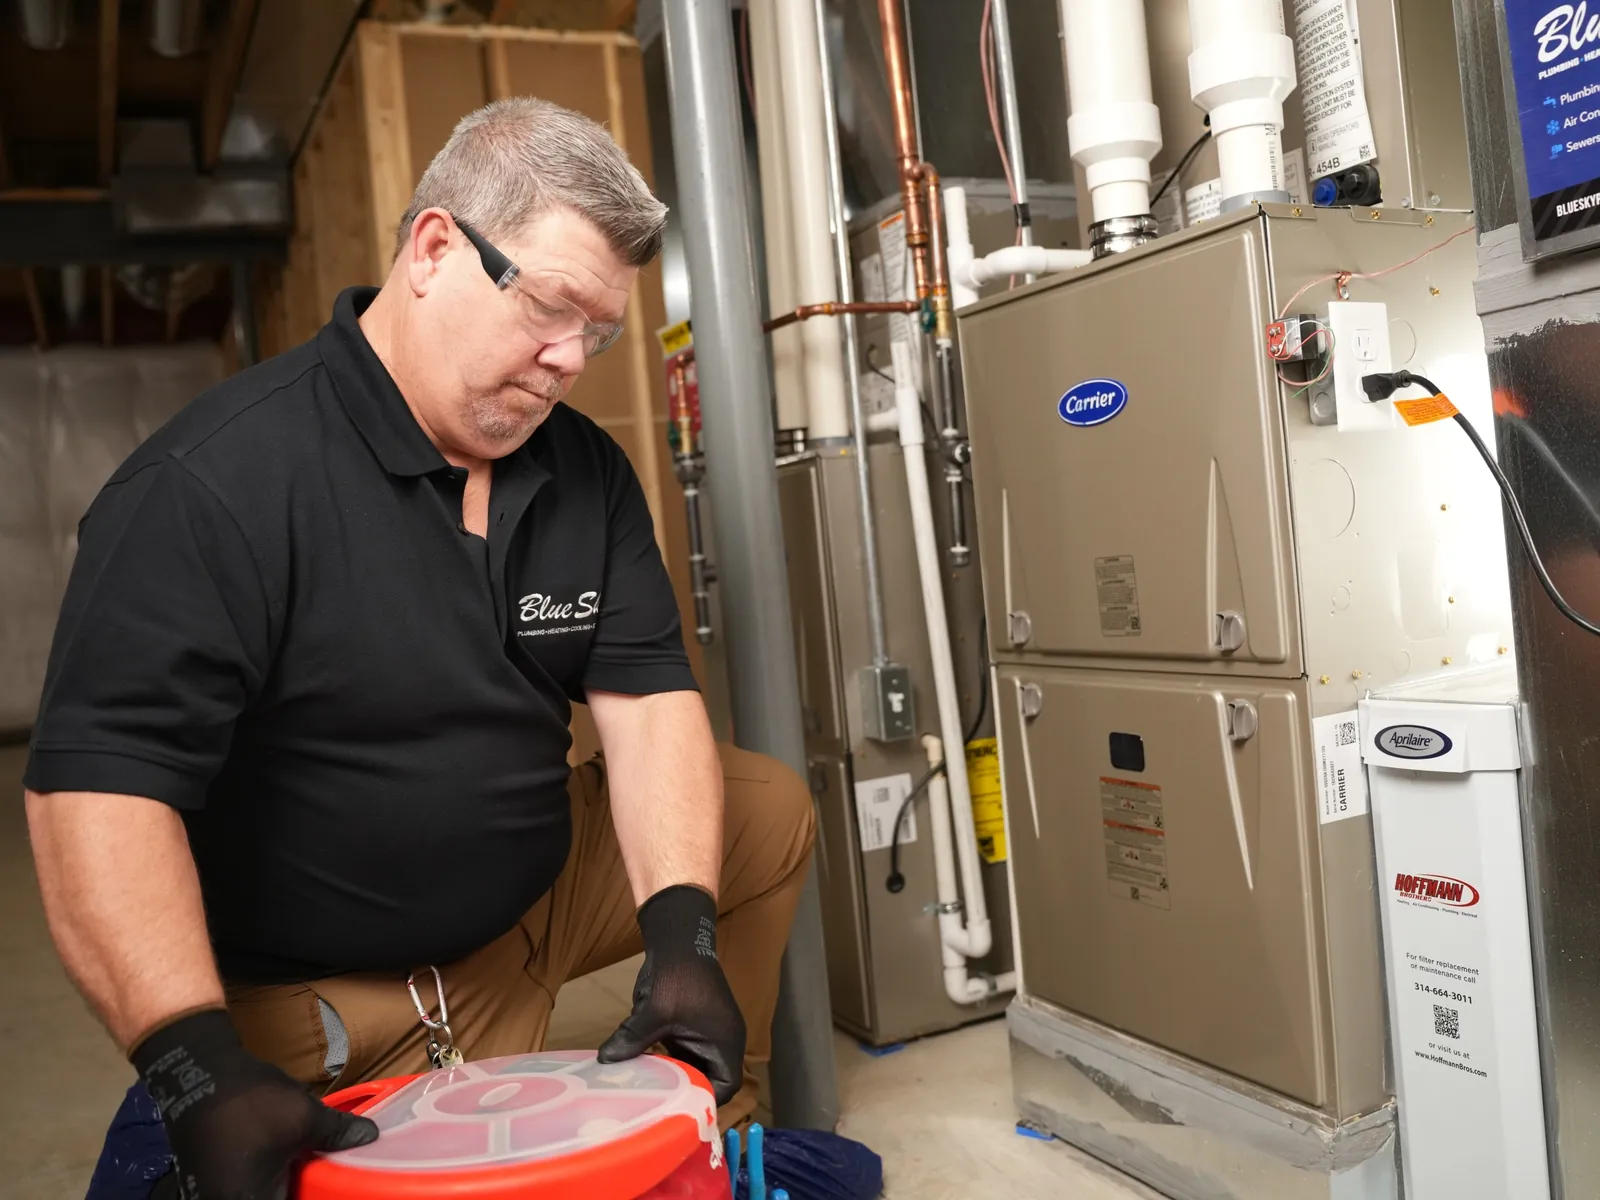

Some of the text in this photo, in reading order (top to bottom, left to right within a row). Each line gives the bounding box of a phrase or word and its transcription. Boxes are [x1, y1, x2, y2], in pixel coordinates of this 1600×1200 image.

[1533, 0, 1600, 63] Blu
[1538, 48, 1600, 80] PLUMBING HEA
[1560, 84, 1600, 105] Plumbin
[1563, 109, 1600, 129] Air Con
[1556, 192, 1600, 217] BLUESKYP
[1066, 391, 1116, 414] Carrier
[518, 593, 573, 622] Blue
[1389, 731, 1432, 748] Aprilaire
[1337, 768, 1348, 811] CARRIER
[1394, 873, 1464, 903] HOFFMANN
[1399, 891, 1433, 903] BROTHERS
[1405, 952, 1480, 976] For filter replacement
[1419, 965, 1462, 981] maintenance
[1463, 975, 1476, 984] call
[1414, 982, 1473, 1004] 314-664-3011
[1414, 1050, 1488, 1078] www.HoffmannBros.com
[1437, 1045, 1452, 1054] visit
[1463, 1052, 1471, 1060] at
